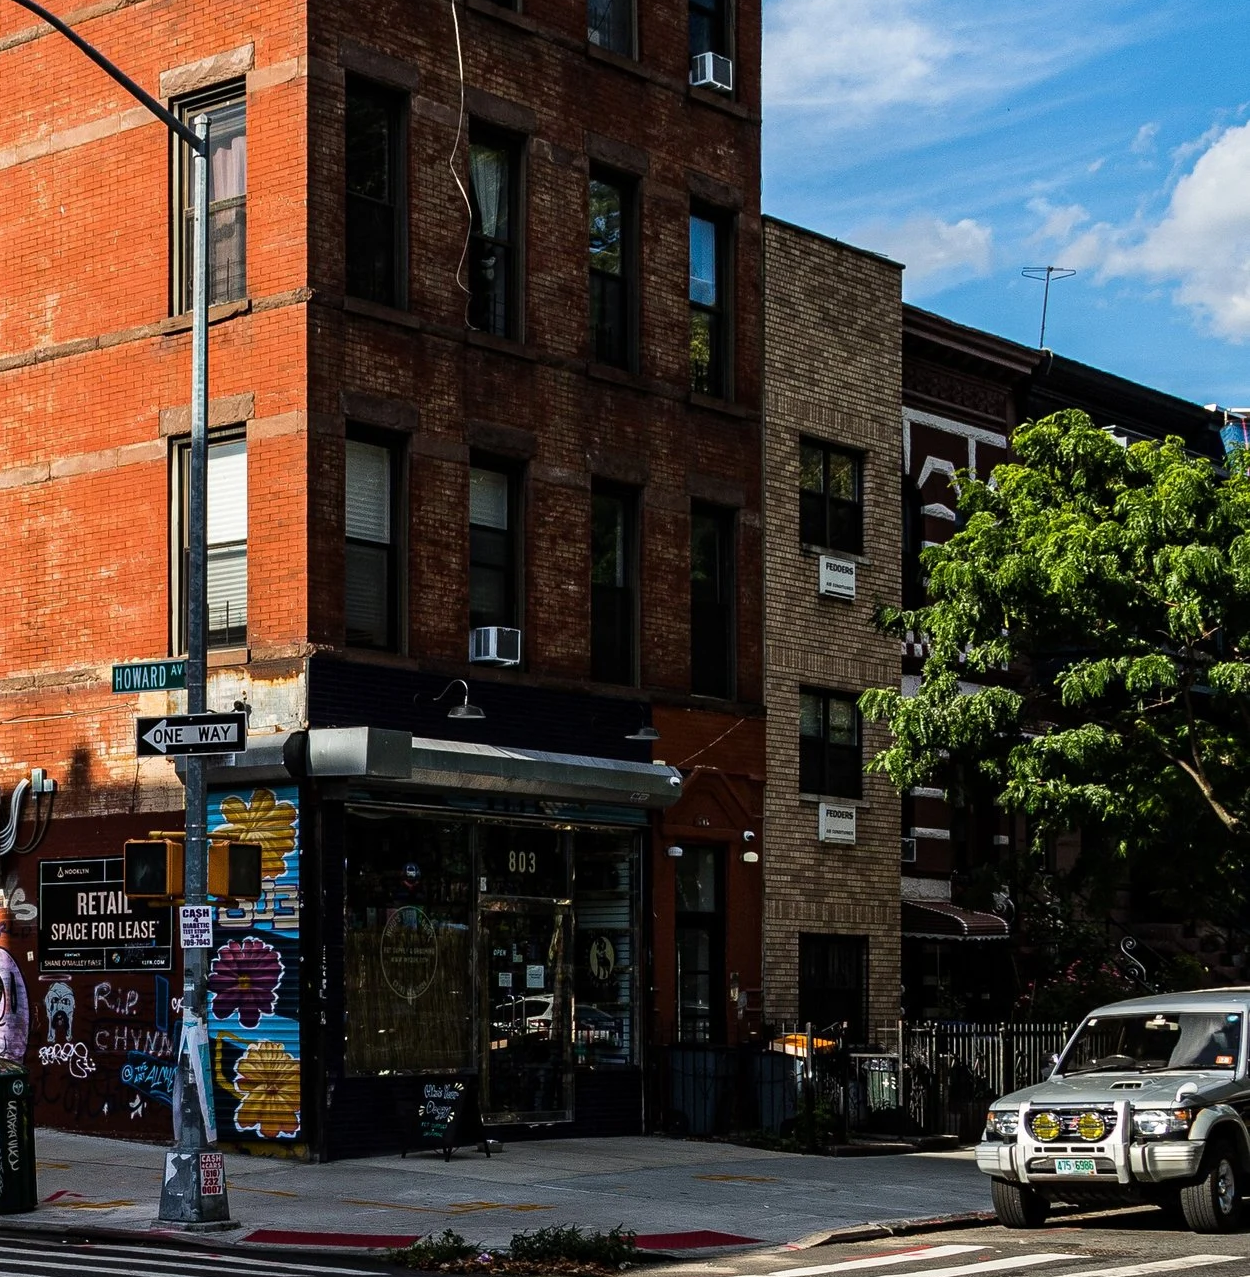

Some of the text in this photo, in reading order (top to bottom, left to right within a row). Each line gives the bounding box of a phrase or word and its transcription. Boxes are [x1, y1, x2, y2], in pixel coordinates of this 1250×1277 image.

[825, 562, 854, 575] FEDDERS
[115, 664, 184, 690] HOWARD AV
[153, 725, 231, 744] ONE WAY
[826, 809, 854, 820] FEDDERS
[508, 850, 536, 873] 803
[77, 891, 133, 916] RETAIL
[51, 922, 88, 941] SPACE
[91, 922, 115, 940] FOR
[183, 938, 211, 946] 709-7043
[493, 949, 507, 957] OPEN
[1057, 1160, 1094, 1171] 475 6986
[203, 1177, 219, 1186] 232
[202, 1185, 222, 1195] 0007
